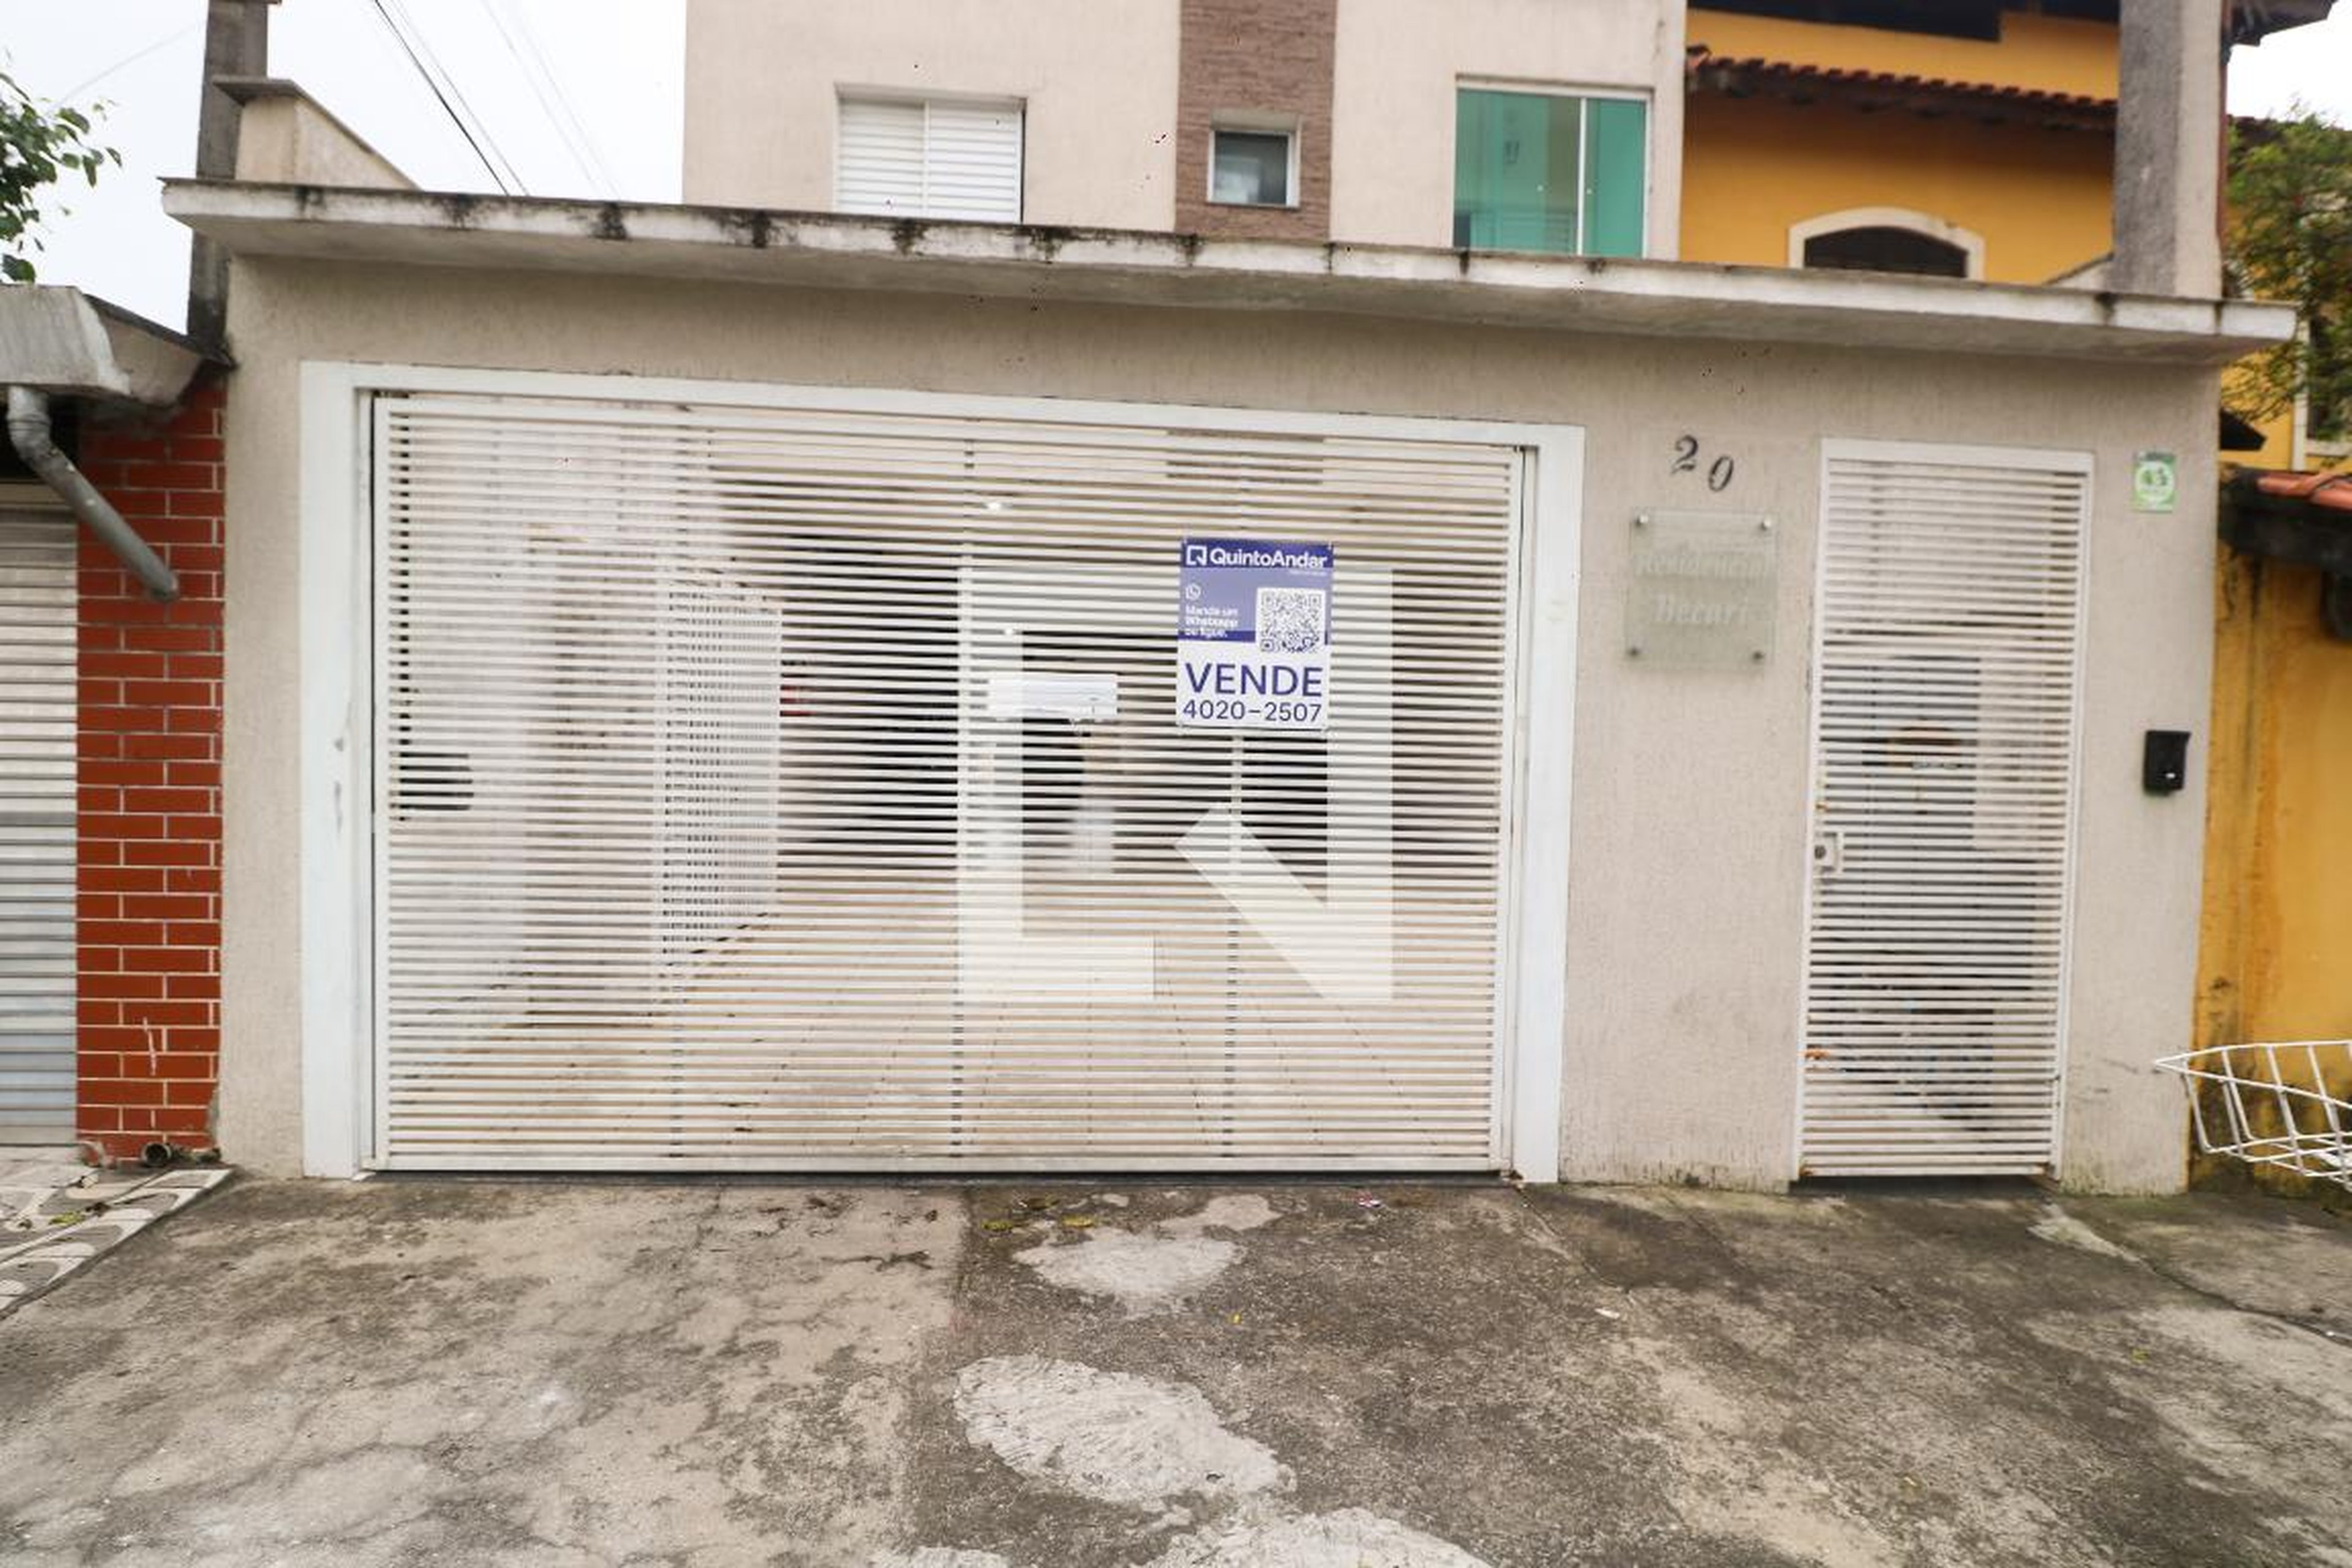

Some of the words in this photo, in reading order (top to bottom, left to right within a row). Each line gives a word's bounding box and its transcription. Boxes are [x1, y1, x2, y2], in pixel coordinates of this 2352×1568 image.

[1670, 434, 1734, 492] 20
[1210, 548, 1328, 568] QuintoAndar
[1185, 663, 1323, 696] VENDE
[1183, 699, 1322, 722] 4020-2507
